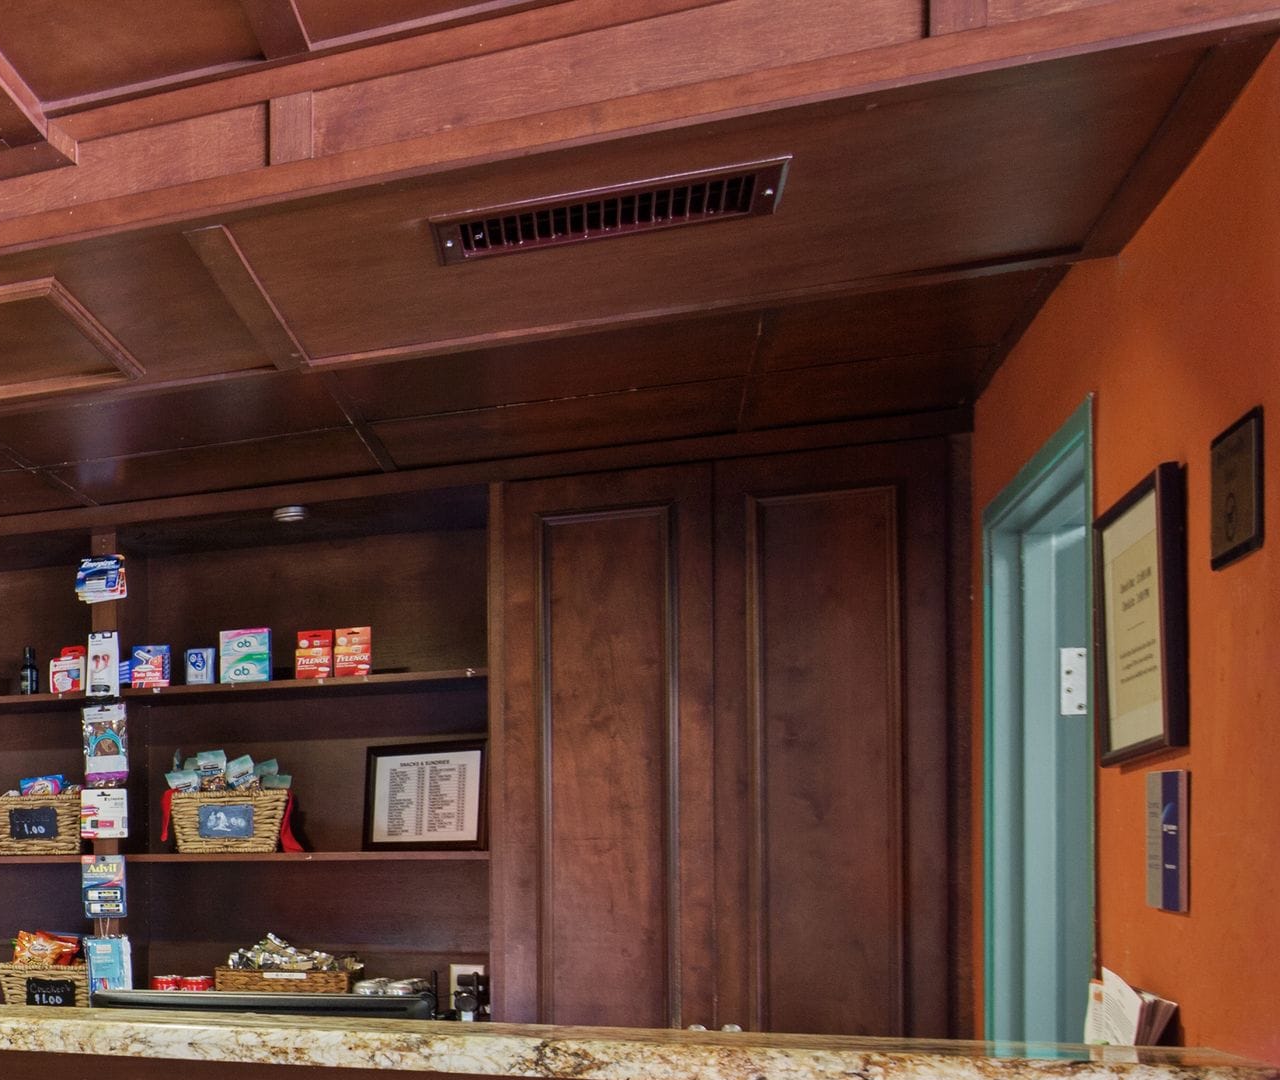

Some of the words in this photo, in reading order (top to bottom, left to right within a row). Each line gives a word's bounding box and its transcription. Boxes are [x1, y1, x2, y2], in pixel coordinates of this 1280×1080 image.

[81, 559, 117, 569] Energizer
[297, 657, 329, 666] TYLENOL
[336, 654, 369, 663] TYLENOL
[88, 863, 117, 873] Advil
